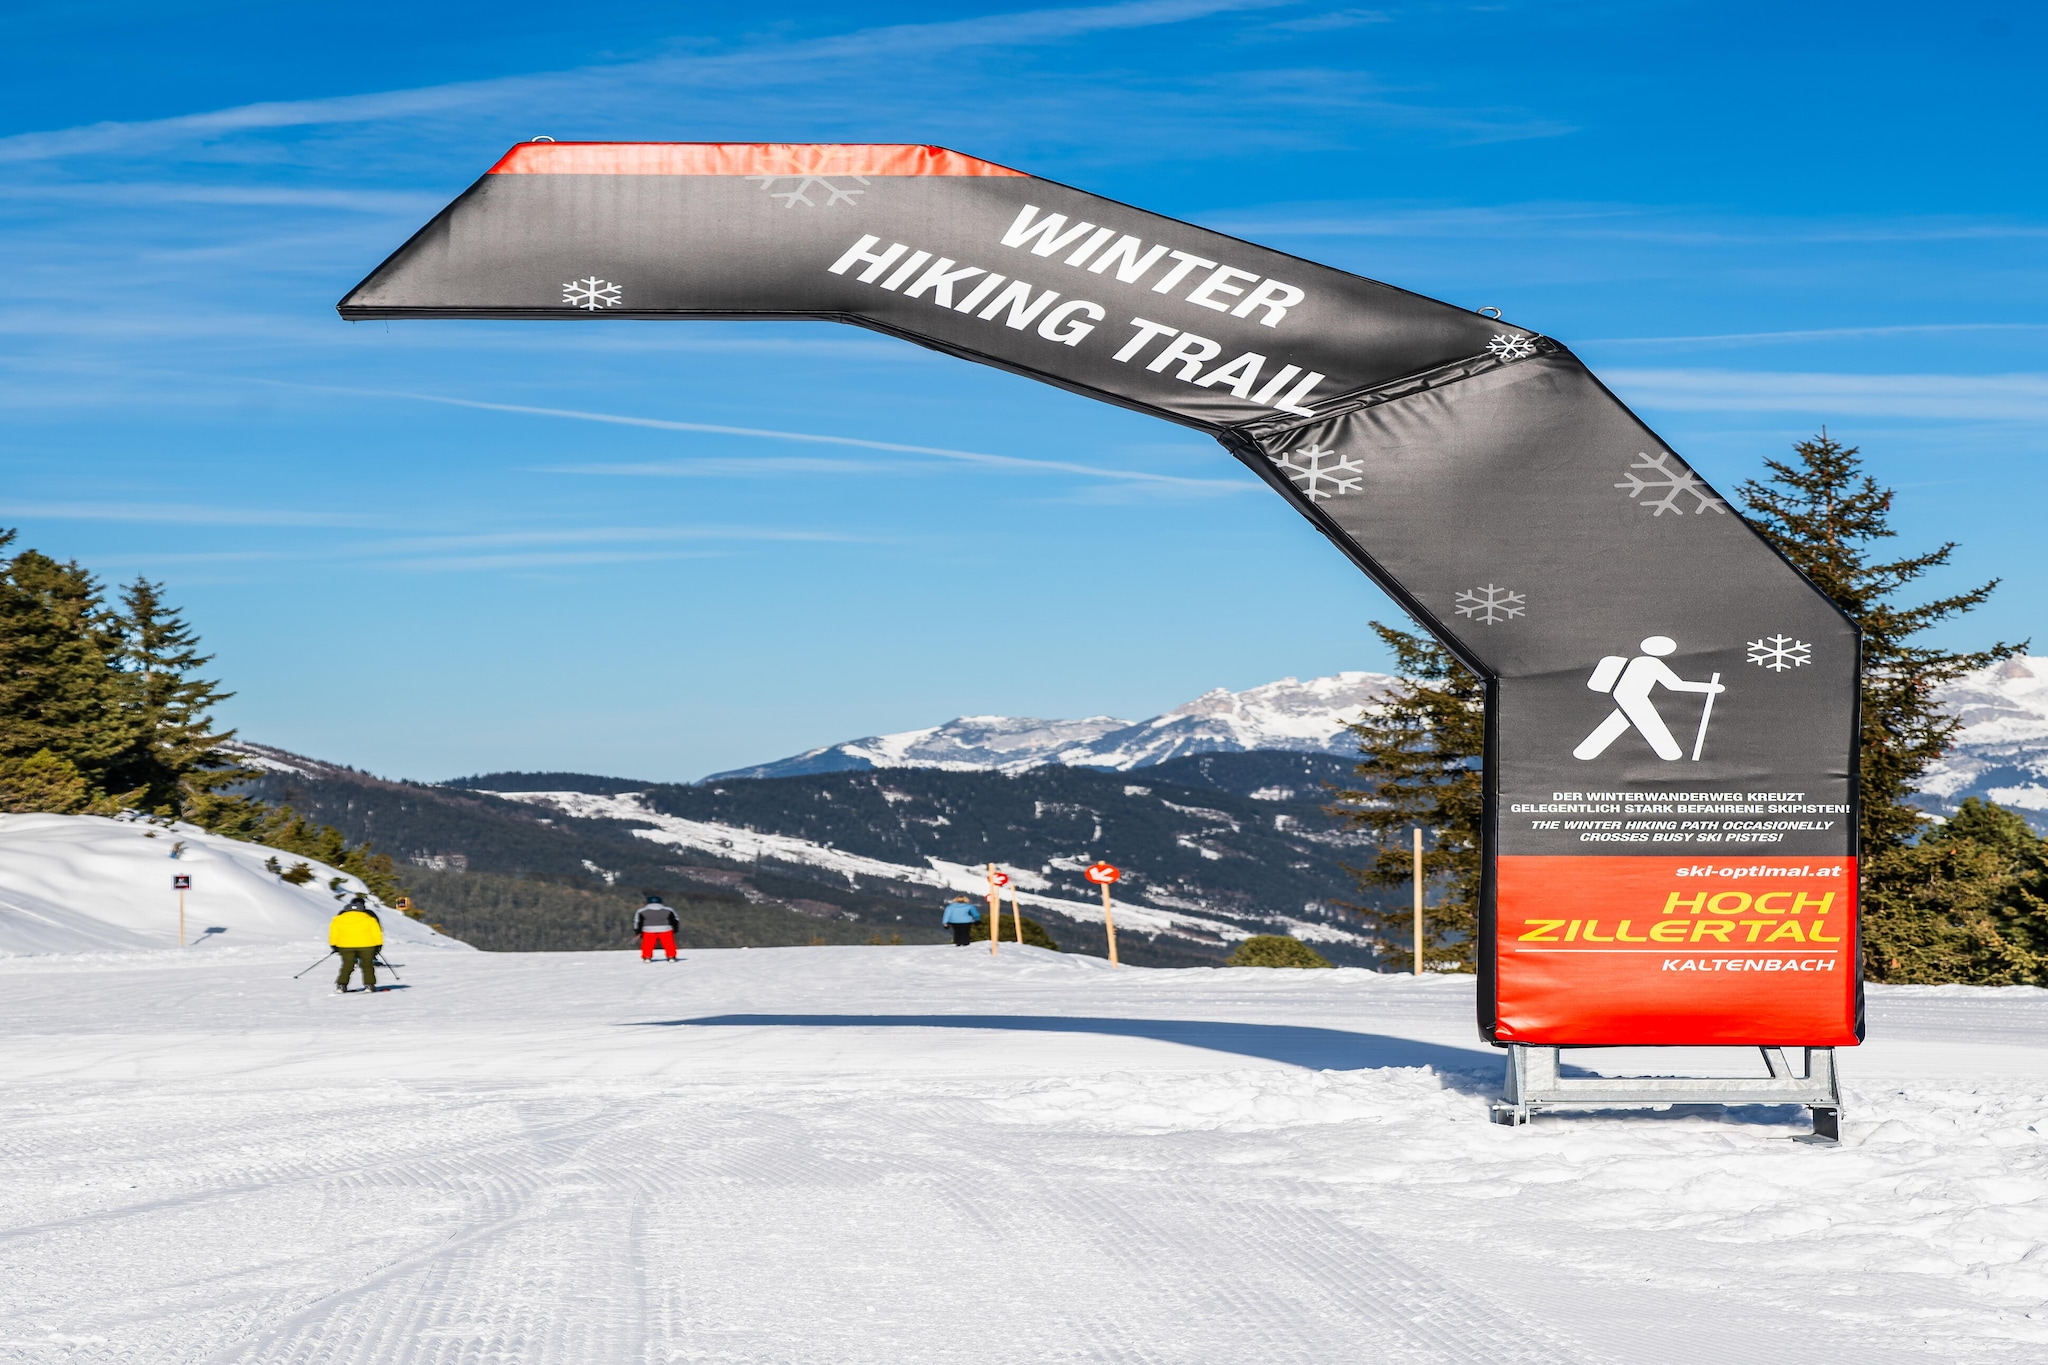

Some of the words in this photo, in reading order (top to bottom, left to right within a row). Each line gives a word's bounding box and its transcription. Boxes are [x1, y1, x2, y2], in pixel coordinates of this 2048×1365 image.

[1000, 204, 1306, 329] WINTER
[827, 234, 1106, 347] HIKING
[1112, 317, 1326, 418] TRAIL
[1552, 792, 1583, 802] DER
[1586, 792, 1743, 802] WINTERWANDERWEG
[1747, 792, 1806, 802] KREUZT
[1510, 804, 1621, 814] GELEGENTLICH
[1624, 804, 1674, 814] STARK
[1677, 804, 1764, 814] BEFAHRENE
[1767, 804, 1851, 814] SKIPISTEN!
[1531, 820, 1561, 830] THE
[1564, 820, 1623, 830] WINTER
[1624, 820, 1678, 831] HIKING
[1680, 821, 1720, 831] PATH
[1722, 820, 1835, 831] OCCASIONELLY
[1579, 832, 1650, 842] CROSSES
[1652, 832, 1695, 842] BUSY
[1696, 832, 1723, 843] SKI
[1725, 832, 1784, 843] PISTES!
[1675, 865, 1842, 880] ski-optimal.at
[1662, 891, 1836, 915] HOCH
[1517, 919, 1841, 943] ZILLERTAL
[1661, 959, 1836, 972] KALTENBACH
